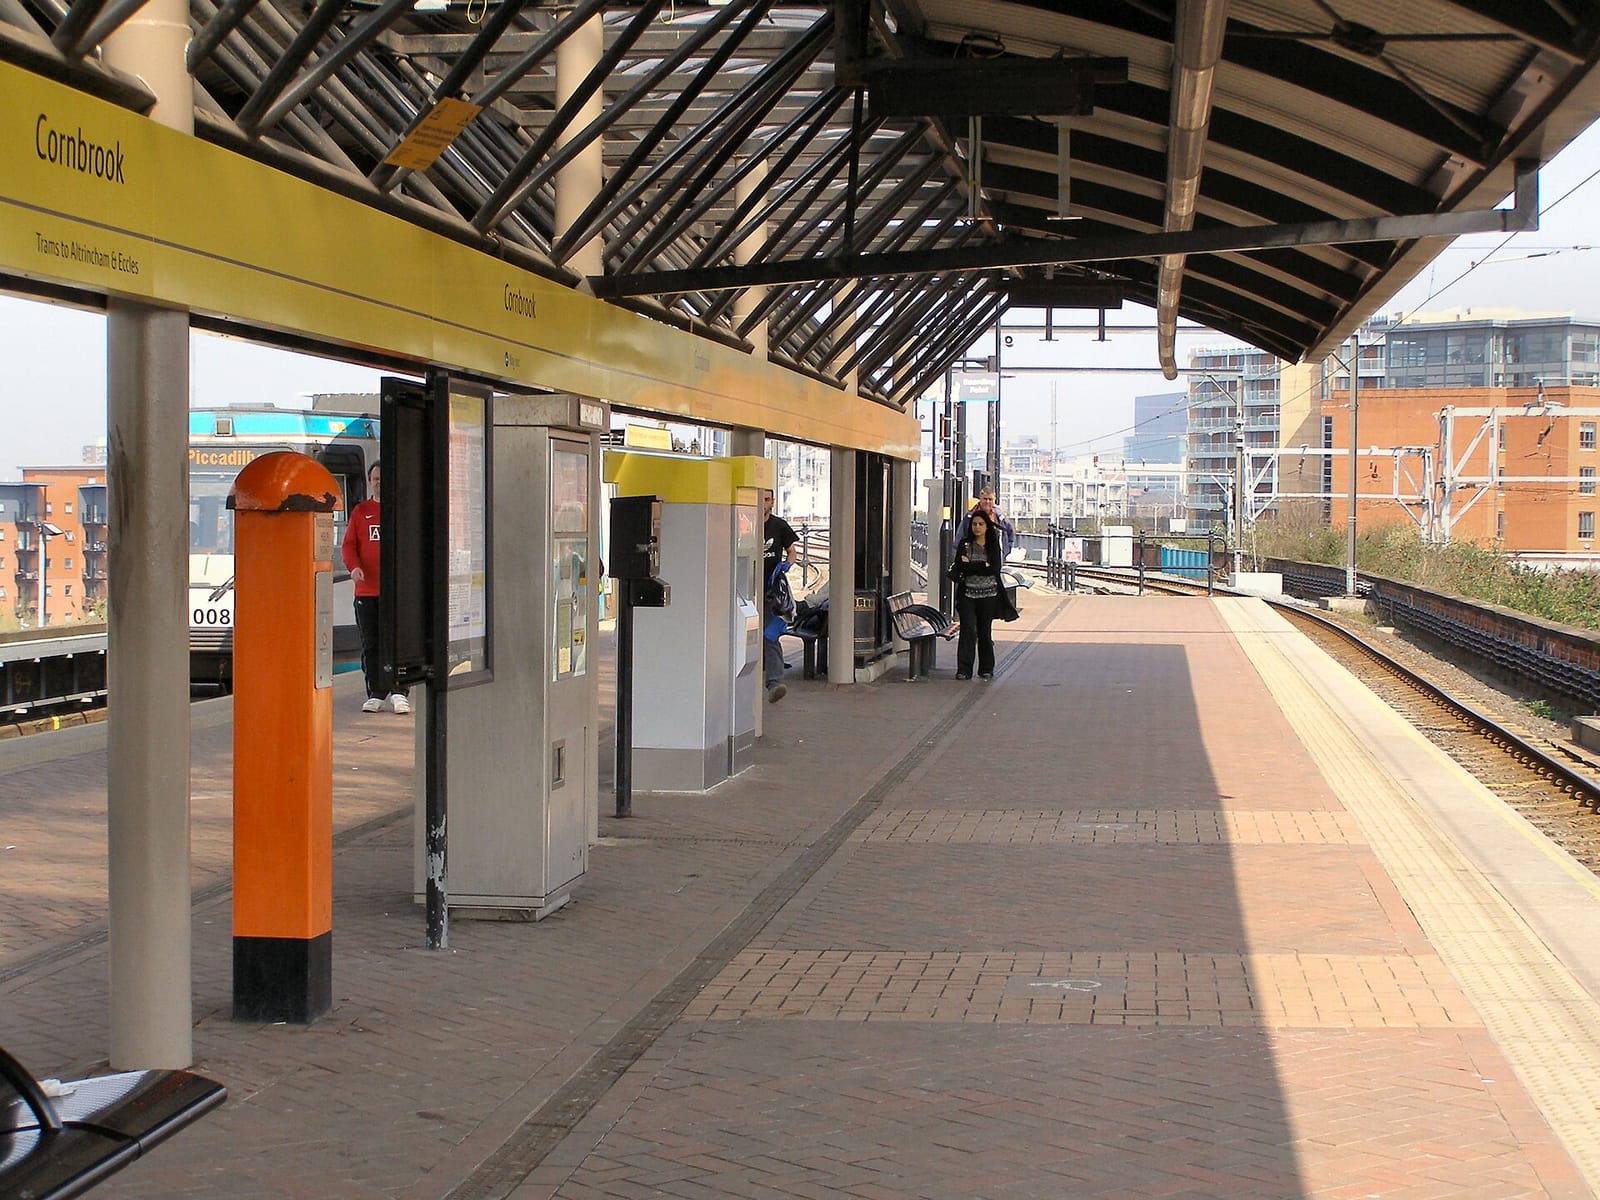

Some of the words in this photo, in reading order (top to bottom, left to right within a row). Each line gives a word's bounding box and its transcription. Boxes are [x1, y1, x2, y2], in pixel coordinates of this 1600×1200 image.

[35, 113, 125, 184] Cornbrook
[36, 231, 60, 257] Trams
[61, 241, 69, 259] to
[71, 241, 110, 269] Altrincham
[111, 250, 117, 270] &
[118, 252, 139, 275] Eccles
[503, 283, 536, 319] Cornbrook
[193, 608, 231, 625] 008
